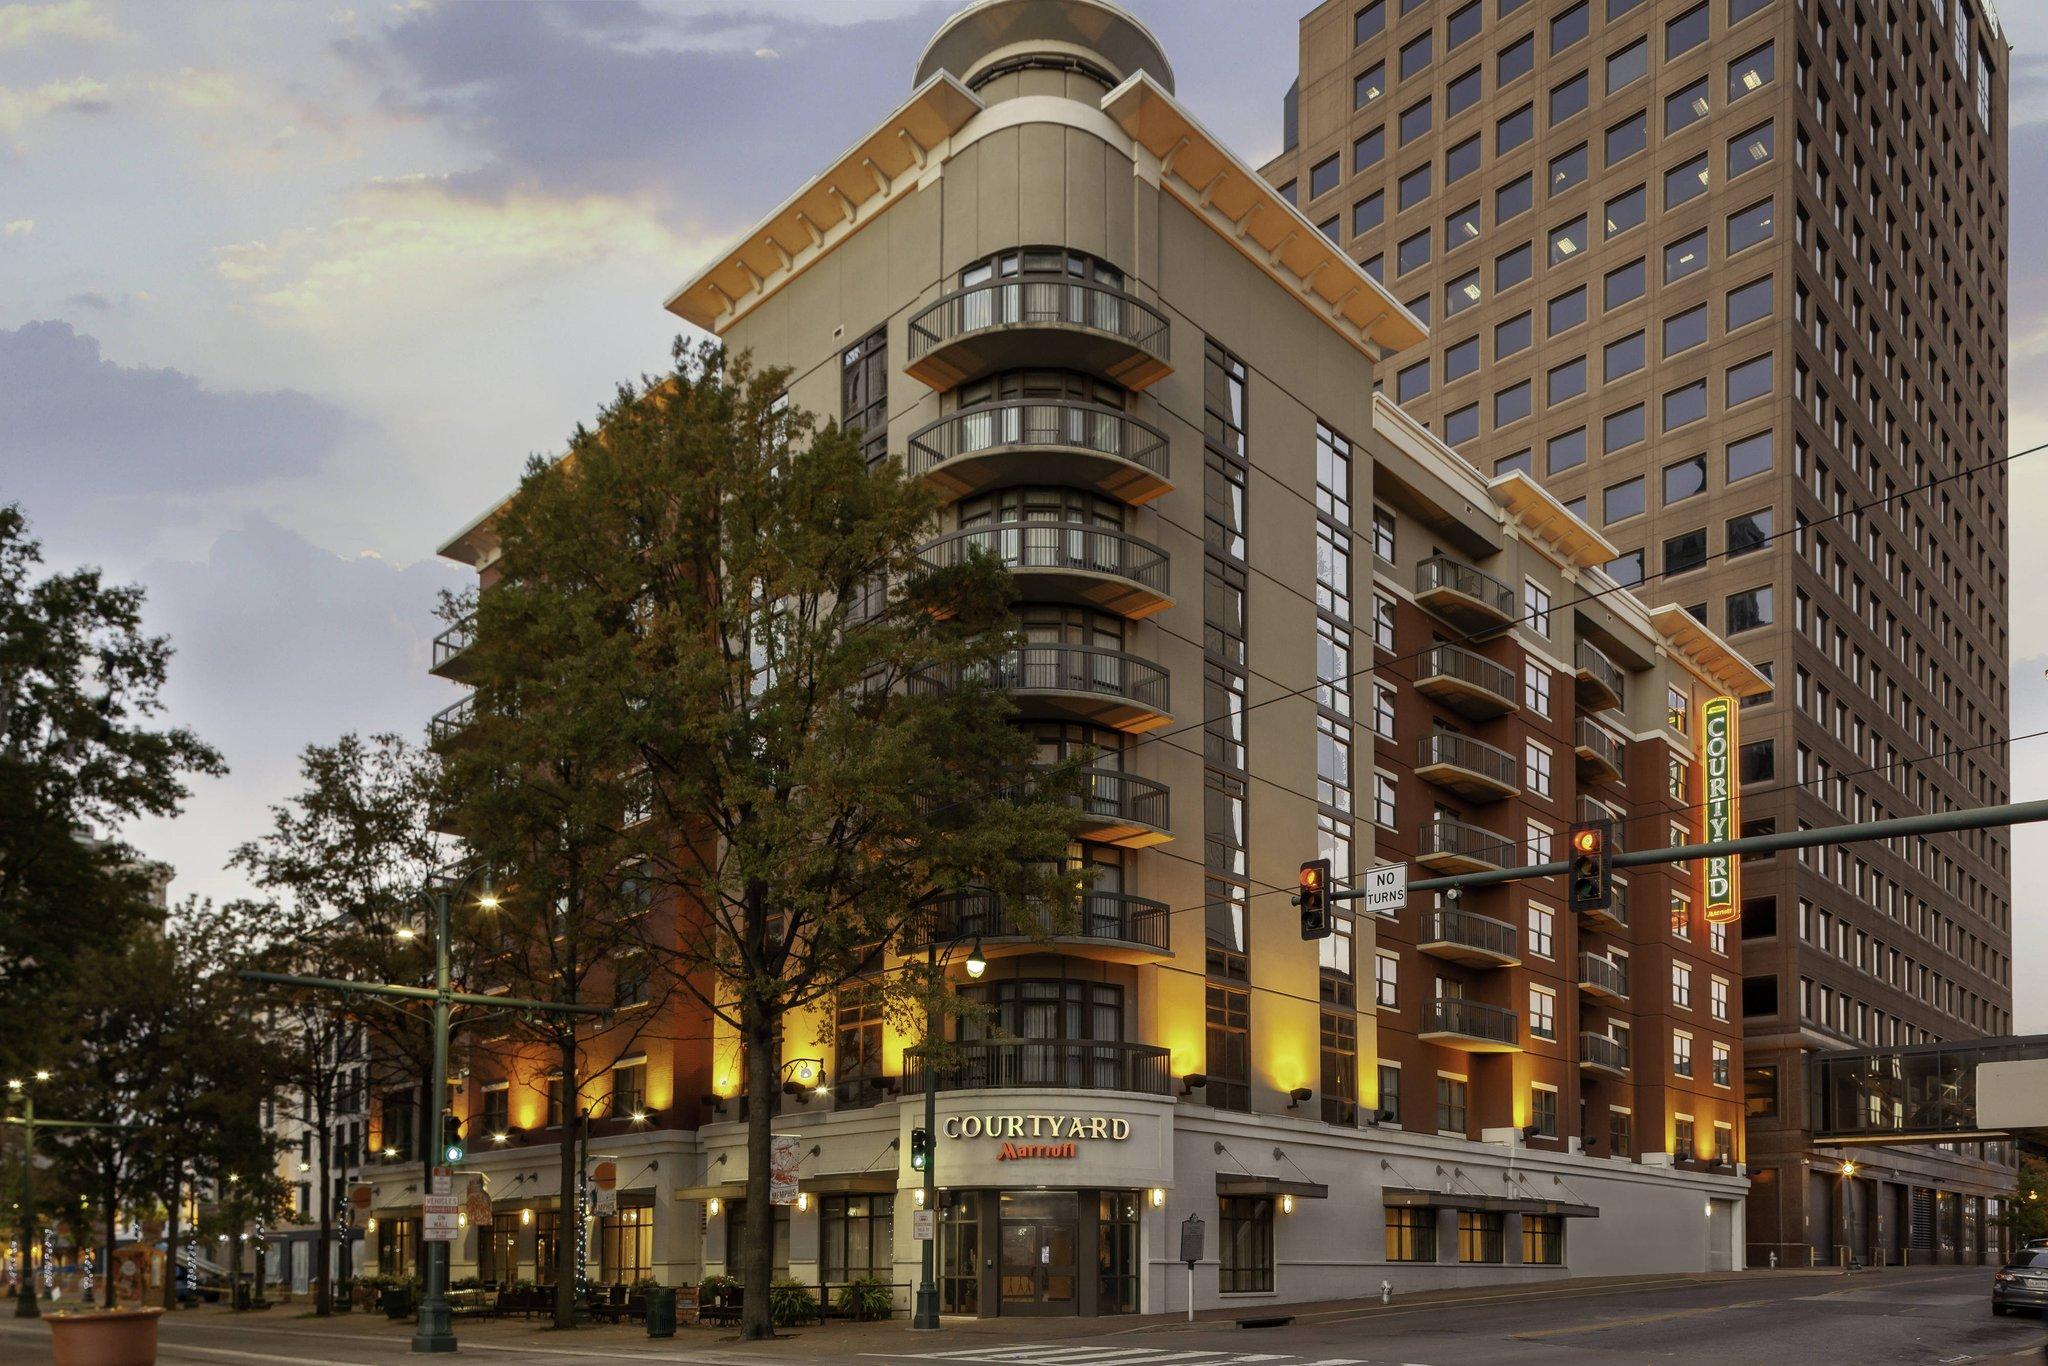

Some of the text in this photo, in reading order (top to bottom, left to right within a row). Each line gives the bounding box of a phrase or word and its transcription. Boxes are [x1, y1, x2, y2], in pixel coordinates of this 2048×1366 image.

[1707, 716, 1728, 898] COURTYRD
[1376, 872, 1395, 887] NO
[1368, 889, 1404, 905] TURNS
[942, 1115, 1131, 1141] COURTYARD
[996, 1141, 1076, 1161] Marriott
[426, 1197, 457, 1206] VEHICLES
[771, 1188, 797, 1199] MEMPHIS
